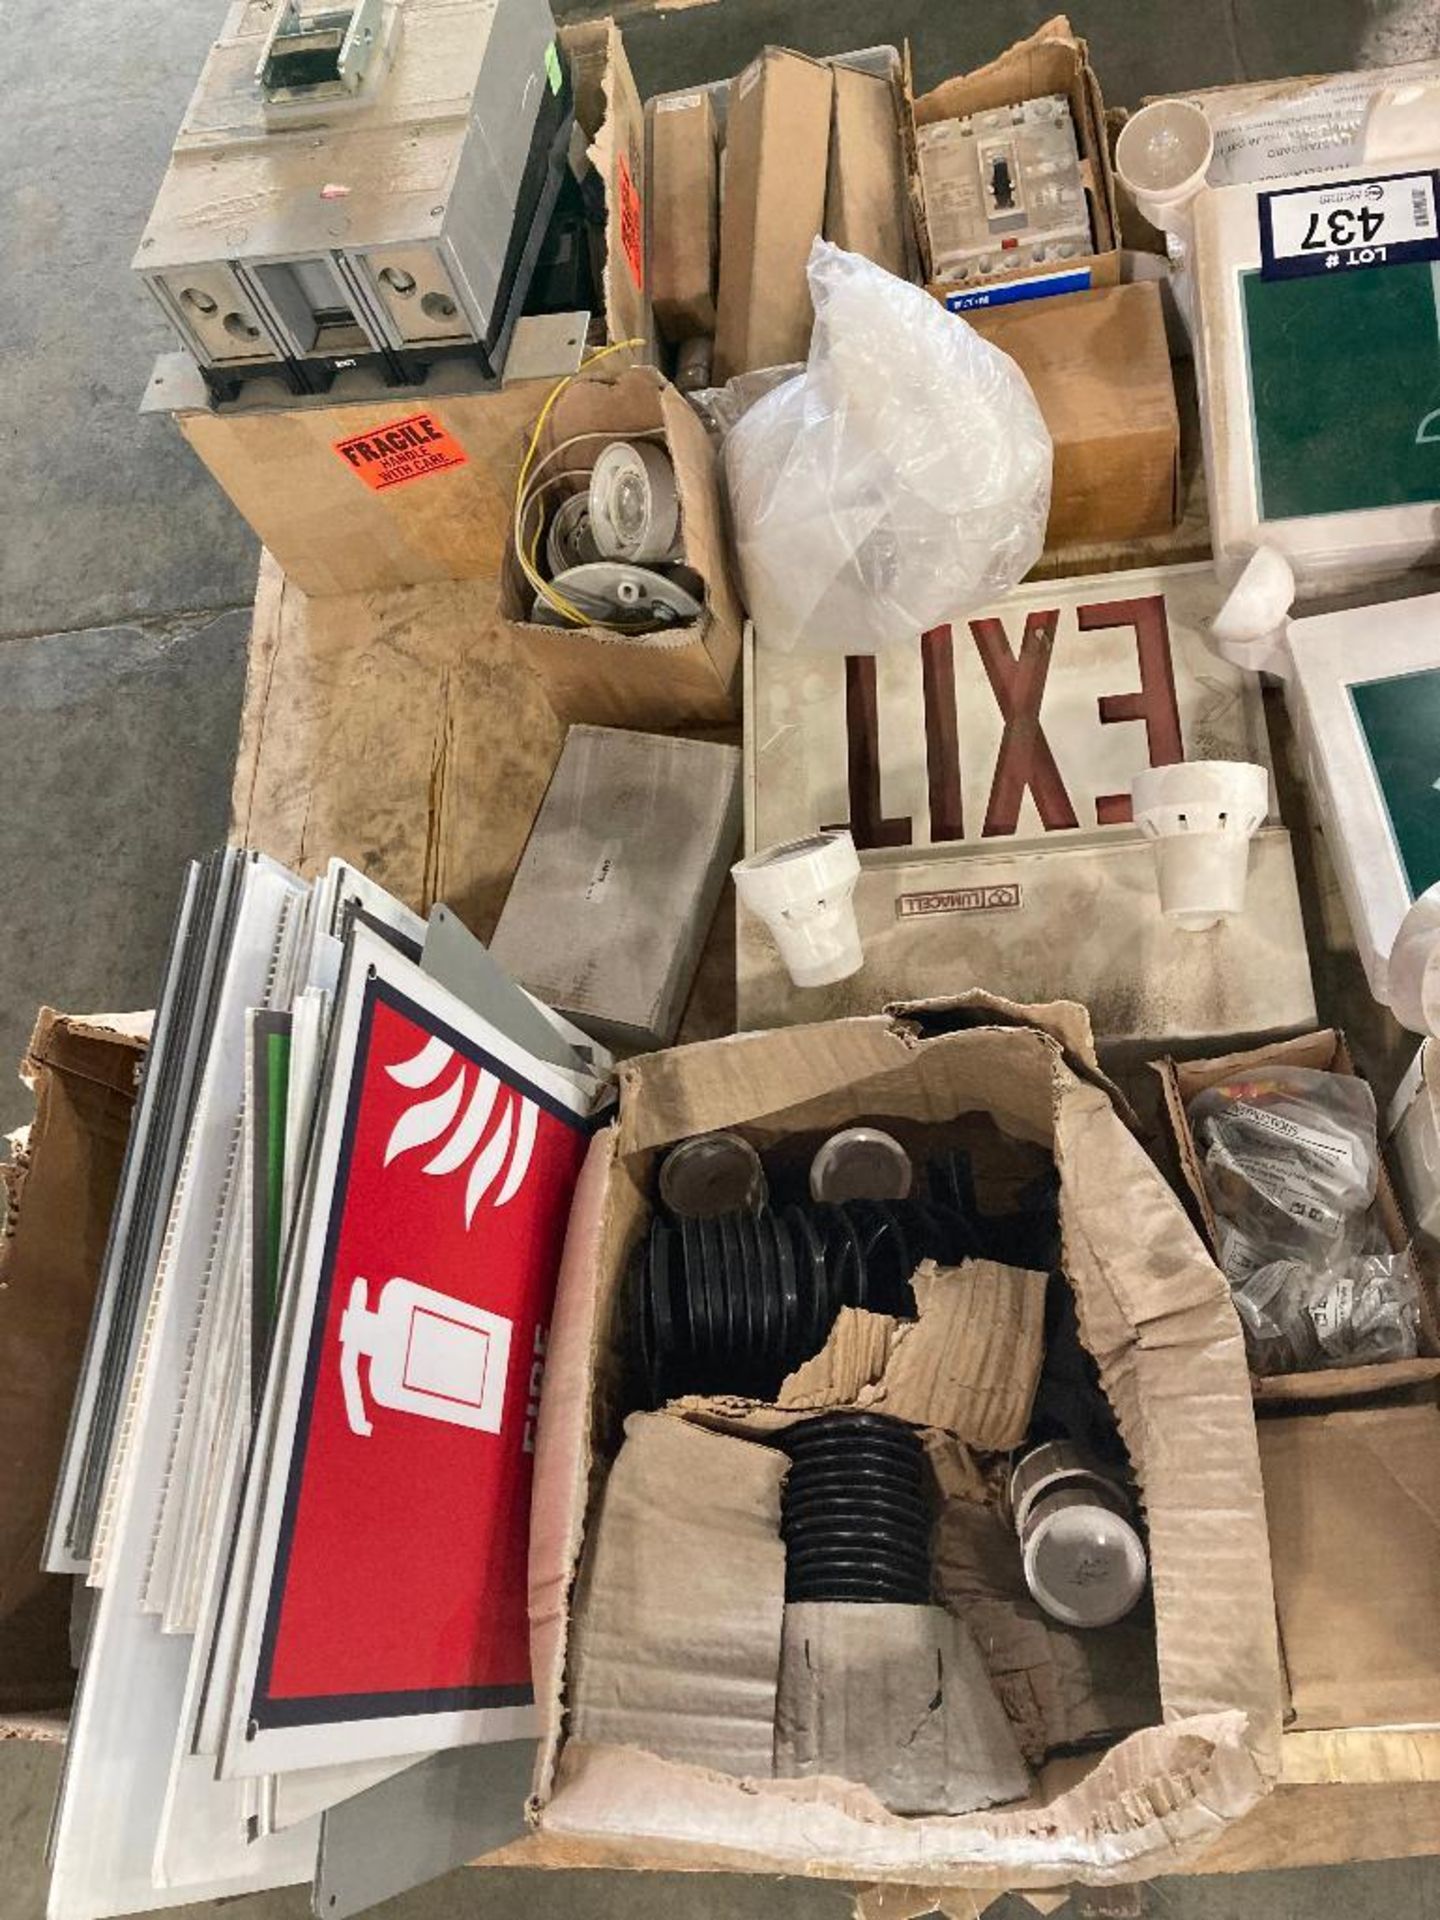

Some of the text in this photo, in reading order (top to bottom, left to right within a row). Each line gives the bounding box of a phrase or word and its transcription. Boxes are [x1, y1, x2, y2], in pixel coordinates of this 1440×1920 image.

[1301, 207, 1385, 250] 437
[1324, 247, 1387, 269] LOT #
[341, 419, 443, 467] FRAGILE
[379, 446, 429, 467] HANDLE
[378, 453, 447, 481] WITH CARE
[820, 595, 1185, 848] EXIT
[904, 893, 980, 911] LUMACELL
